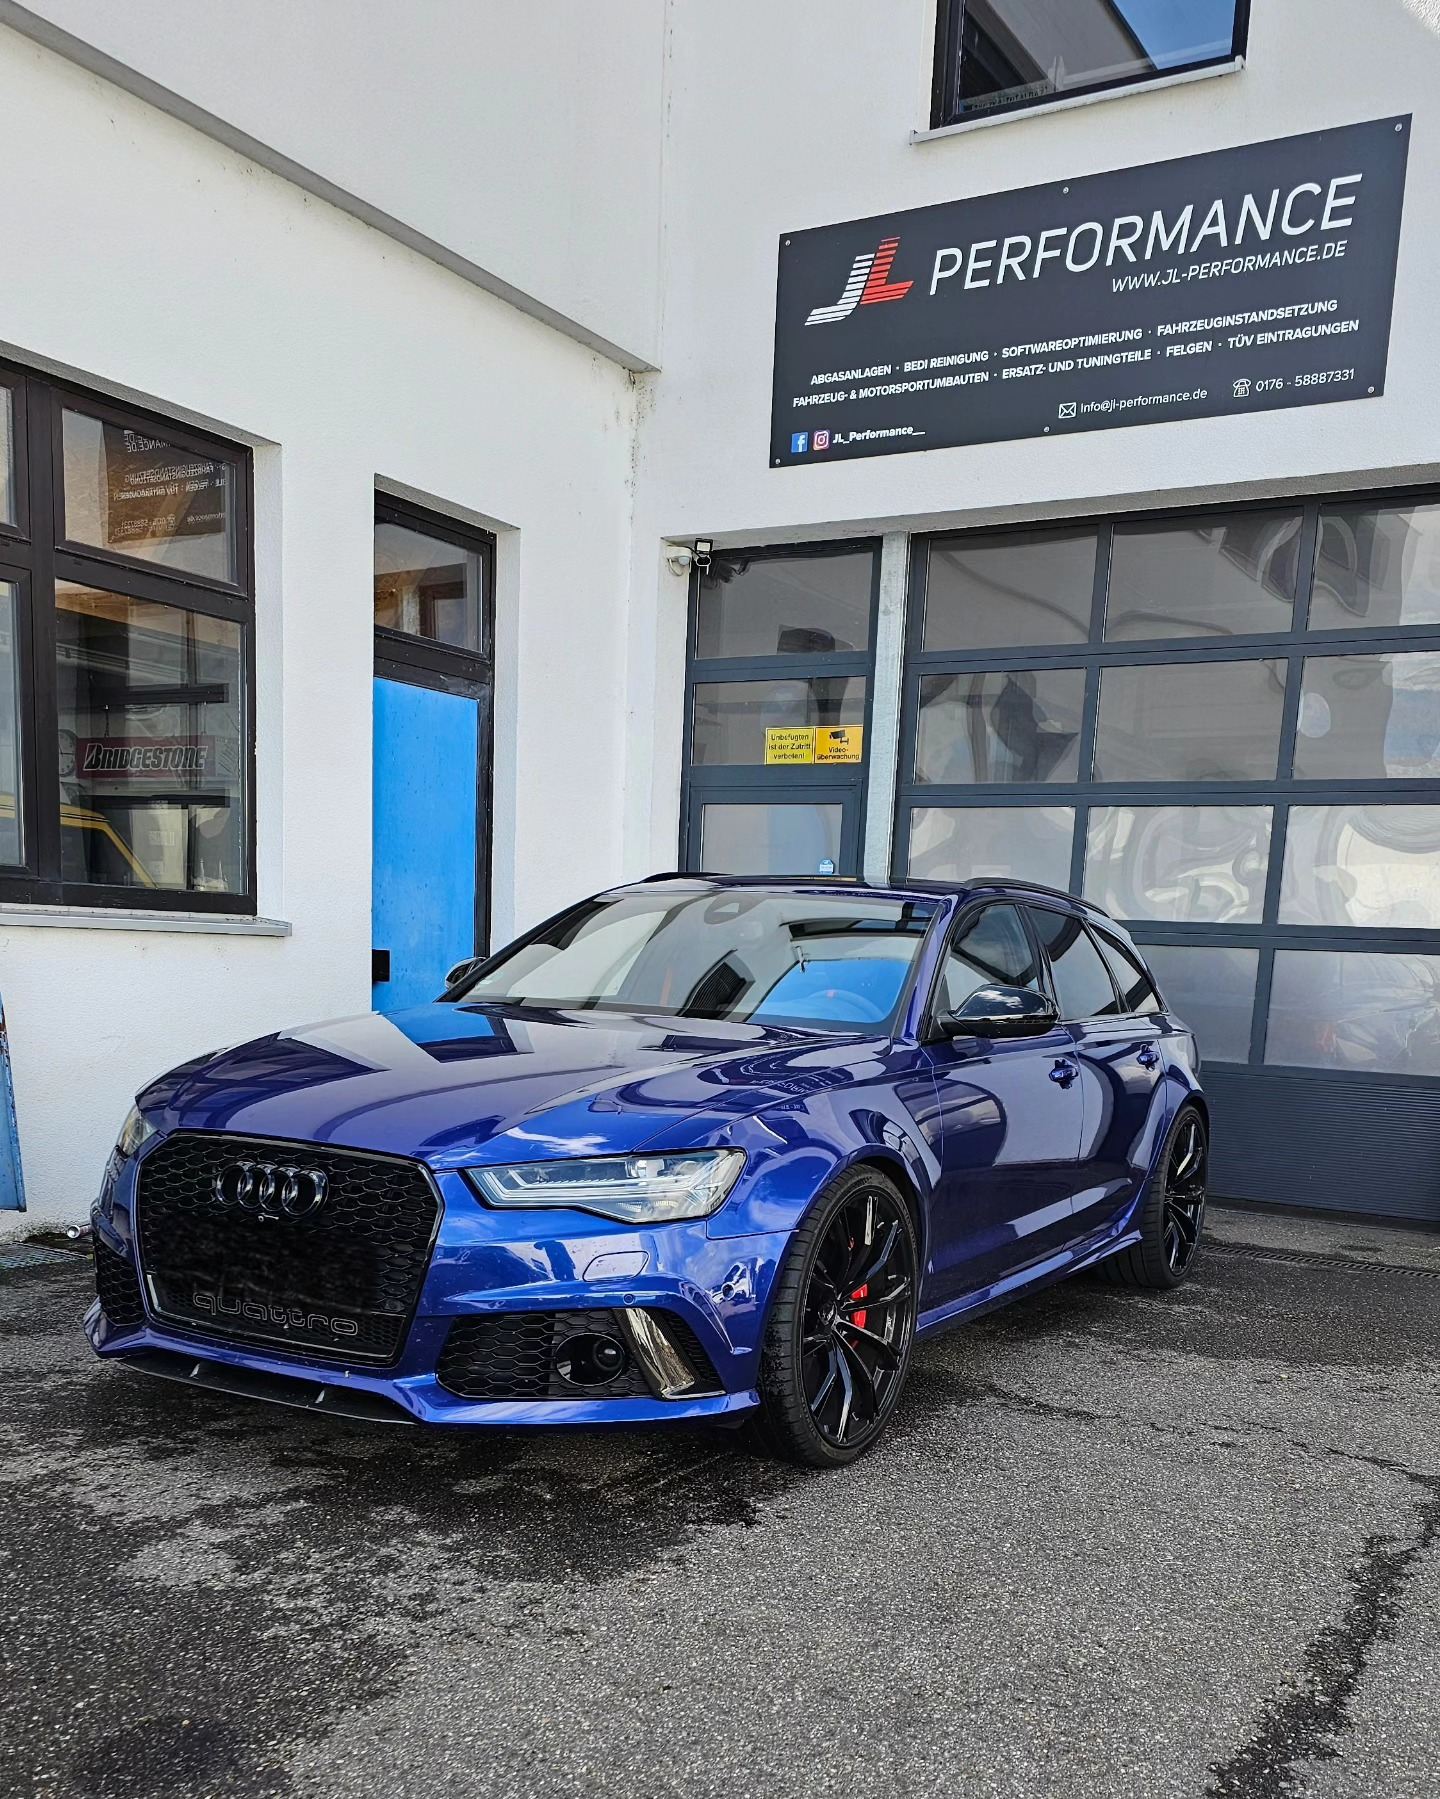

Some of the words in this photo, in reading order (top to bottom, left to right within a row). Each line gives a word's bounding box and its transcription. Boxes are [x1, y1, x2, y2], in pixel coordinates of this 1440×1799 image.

[804, 236, 914, 326] JL
[929, 172, 1363, 296] PERFORMANCE
[1112, 239, 1348, 293] WWW.JL-PERFORMANCE.DE
[792, 391, 849, 408] FAHRZEUG-
[849, 389, 857, 402] &
[858, 371, 990, 399] MOTORSPORTUMBAUTEN
[1001, 363, 1047, 380] ERSATZ-
[1048, 359, 1075, 373] UND
[1076, 348, 1152, 369] TUNINGTEILE
[1165, 340, 1213, 358] FELGEN
[1227, 333, 1255, 349] TÜV
[1256, 319, 1360, 345] EINTRAGUNGEN
[810, 364, 892, 386] ABGASANLAGEN
[903, 359, 929, 373] BEDI
[929, 350, 989, 369] REINIGUNG
[1001, 328, 1143, 359] SOFTWAREOPTIMIERUNG
[1156, 299, 1338, 337] FAHRZEUGINSTANDSETZUNG
[1255, 377, 1284, 392] 0176
[1294, 367, 1355, 387] 58887331
[83, 743, 208, 771] BRIDGESTONE
[771, 734, 809, 742] Unbefugten
[192, 1292, 358, 1336] quattro
